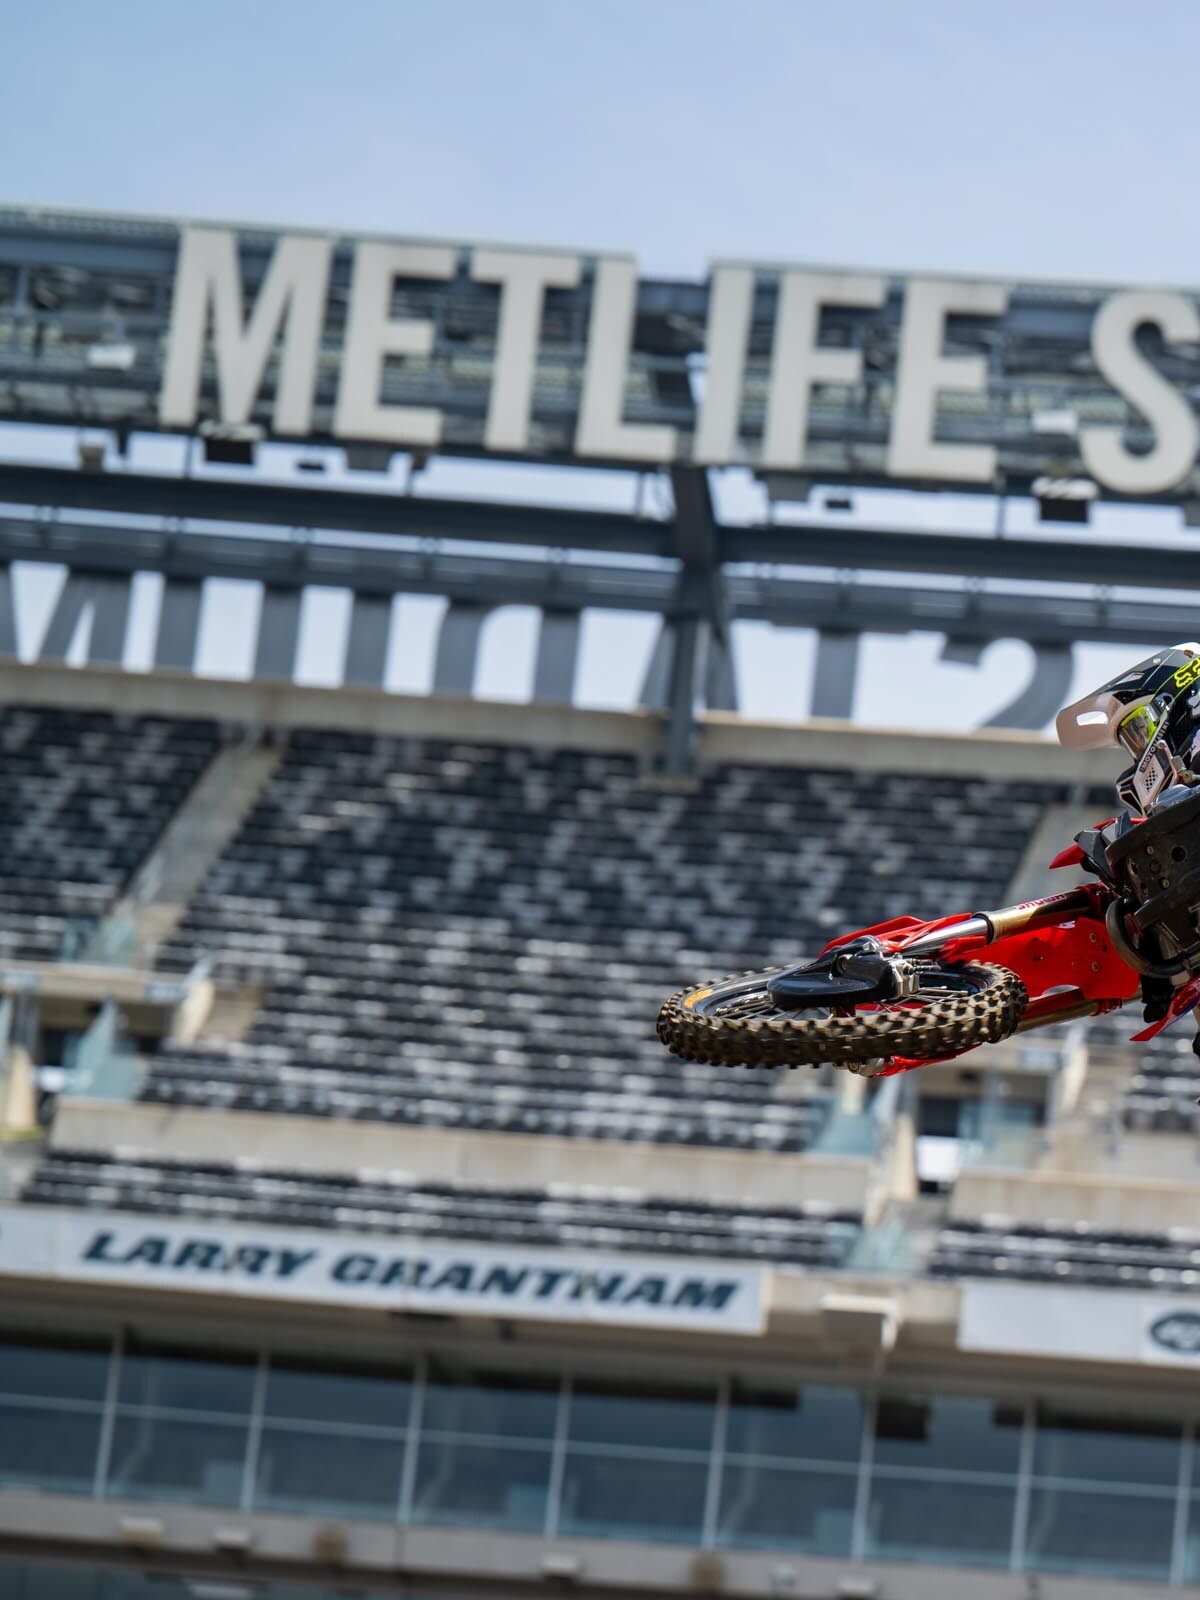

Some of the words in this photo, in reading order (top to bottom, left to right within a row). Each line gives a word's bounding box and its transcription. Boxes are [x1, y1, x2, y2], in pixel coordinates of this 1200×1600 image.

[158, 227, 1011, 482] METLIFE
[84, 1231, 314, 1283] LARRY
[331, 1255, 742, 1311] GRANTHAM
